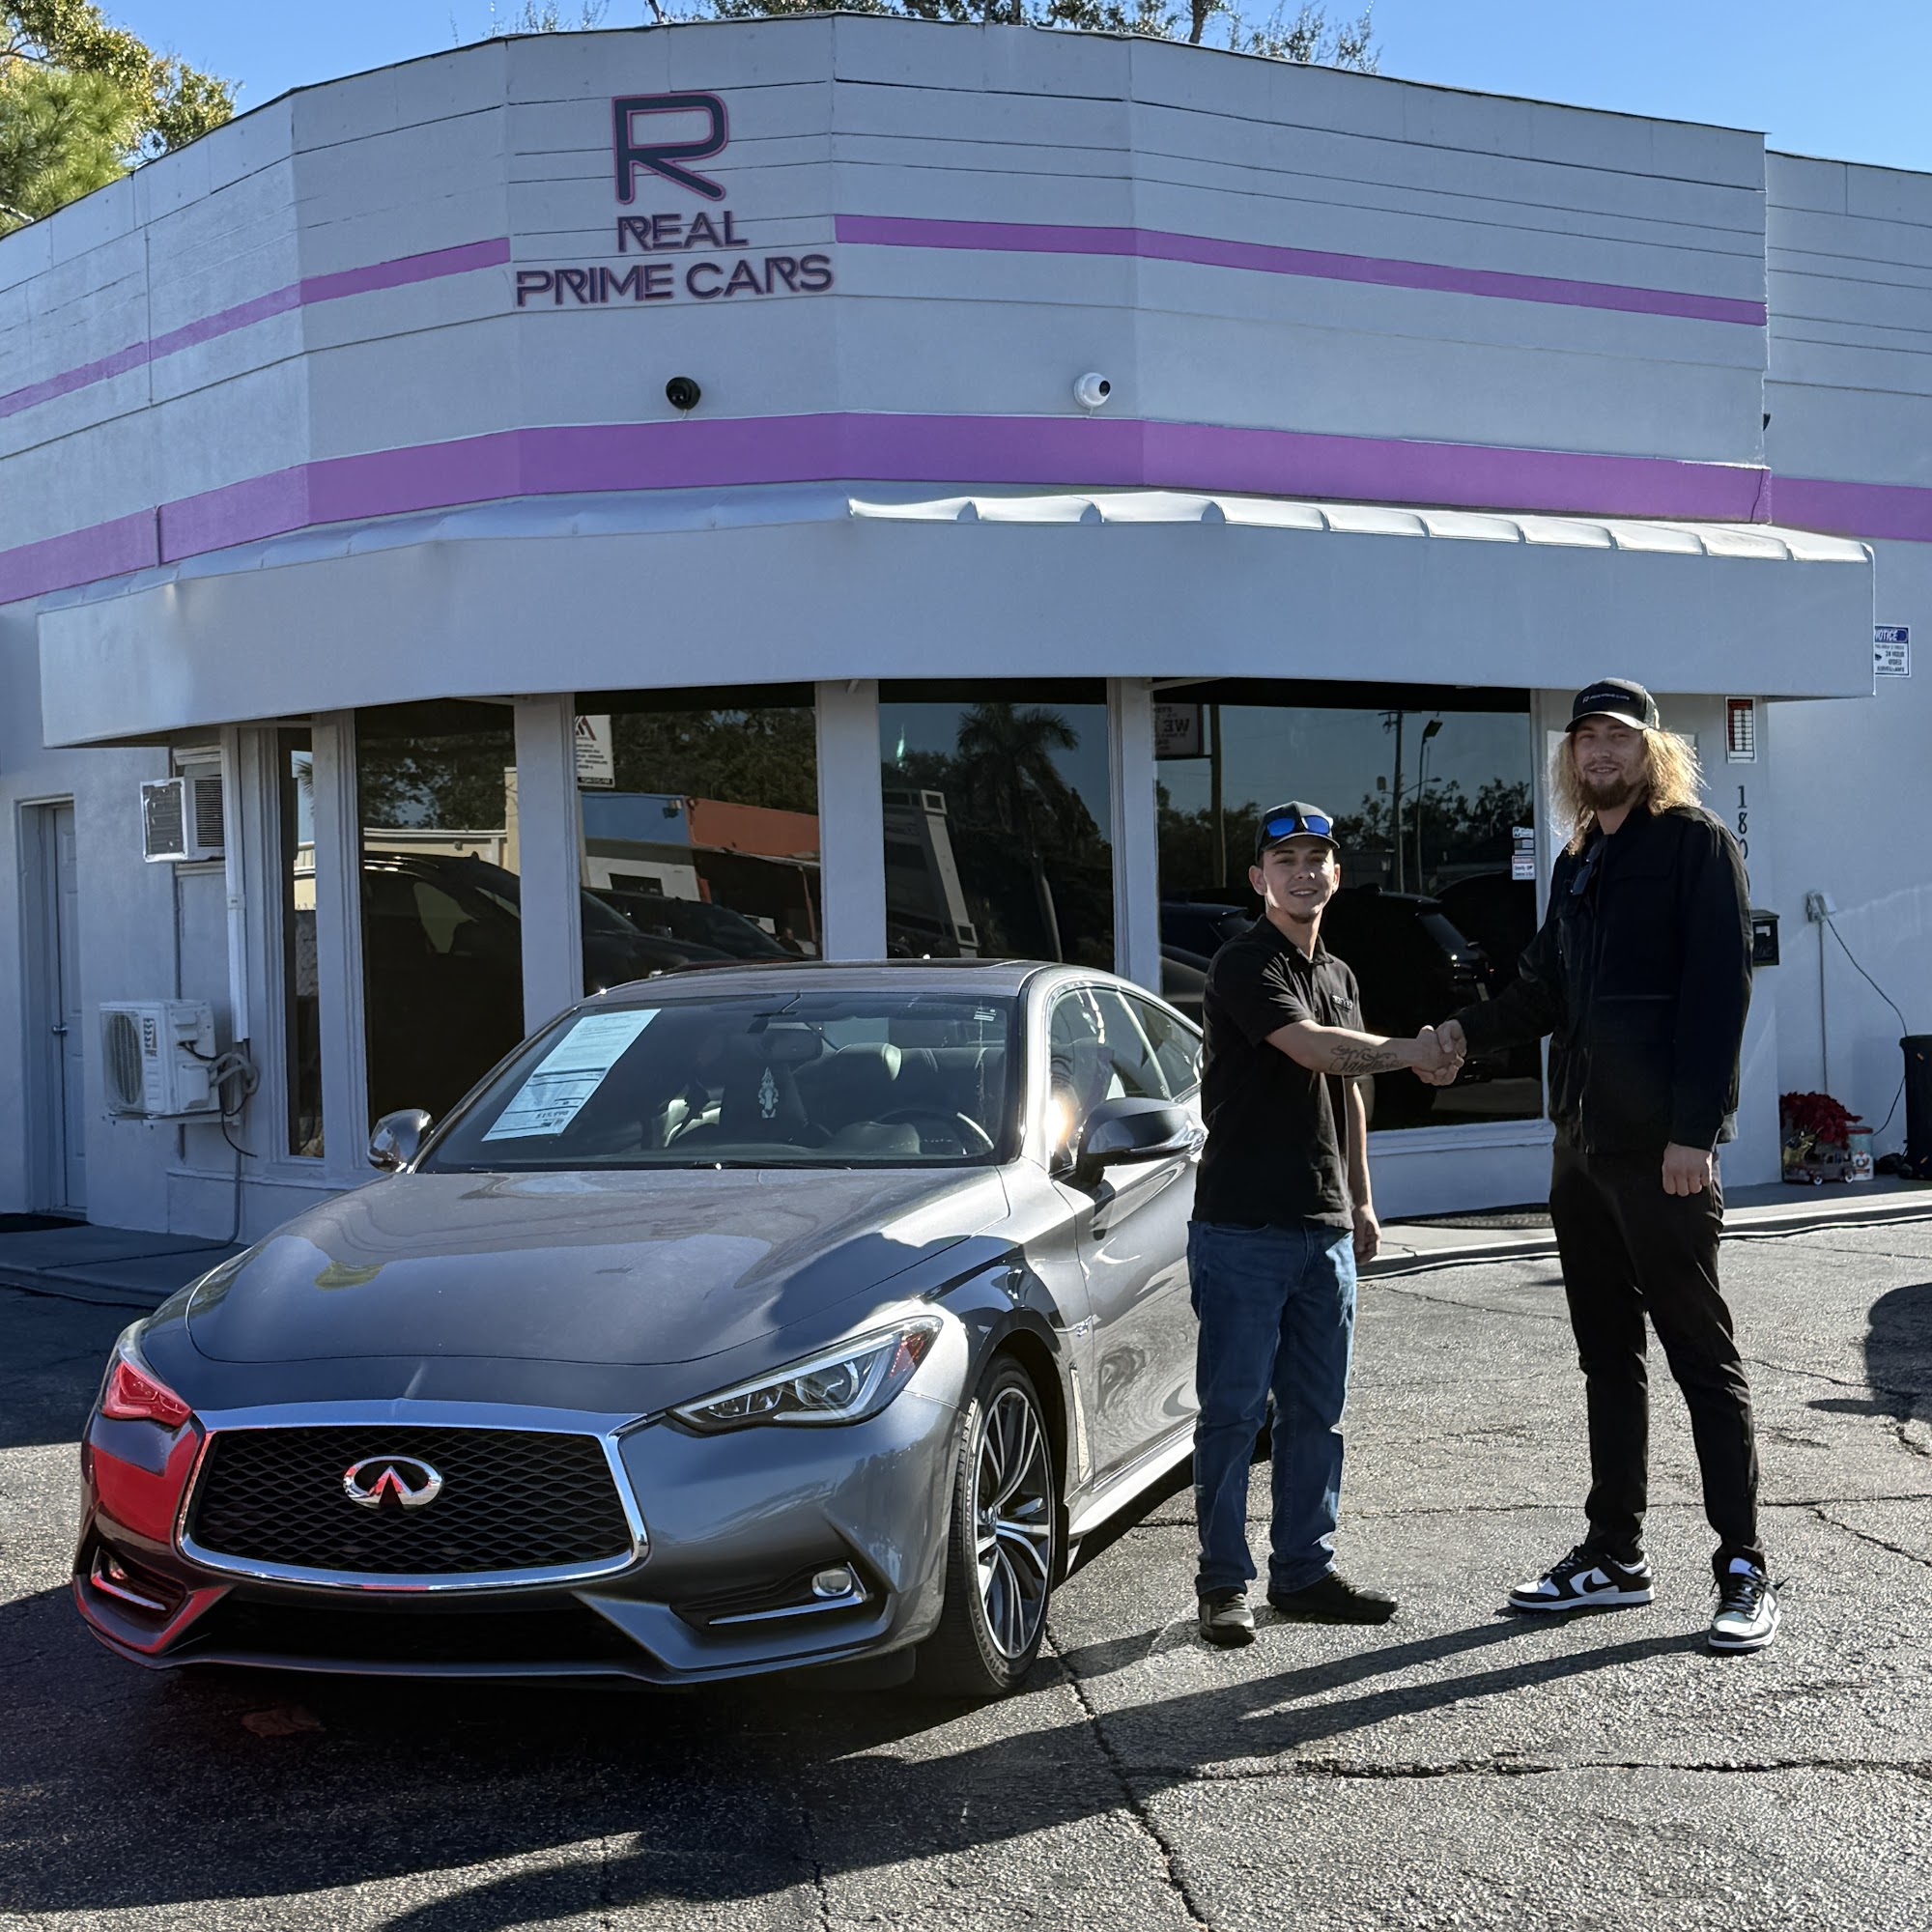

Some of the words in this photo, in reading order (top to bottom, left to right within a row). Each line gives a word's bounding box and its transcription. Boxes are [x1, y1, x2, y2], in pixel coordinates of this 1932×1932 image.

[611, 91, 729, 205] R
[616, 211, 750, 253] REAL
[516, 263, 674, 307] PRIME
[685, 254, 835, 299] CARS
